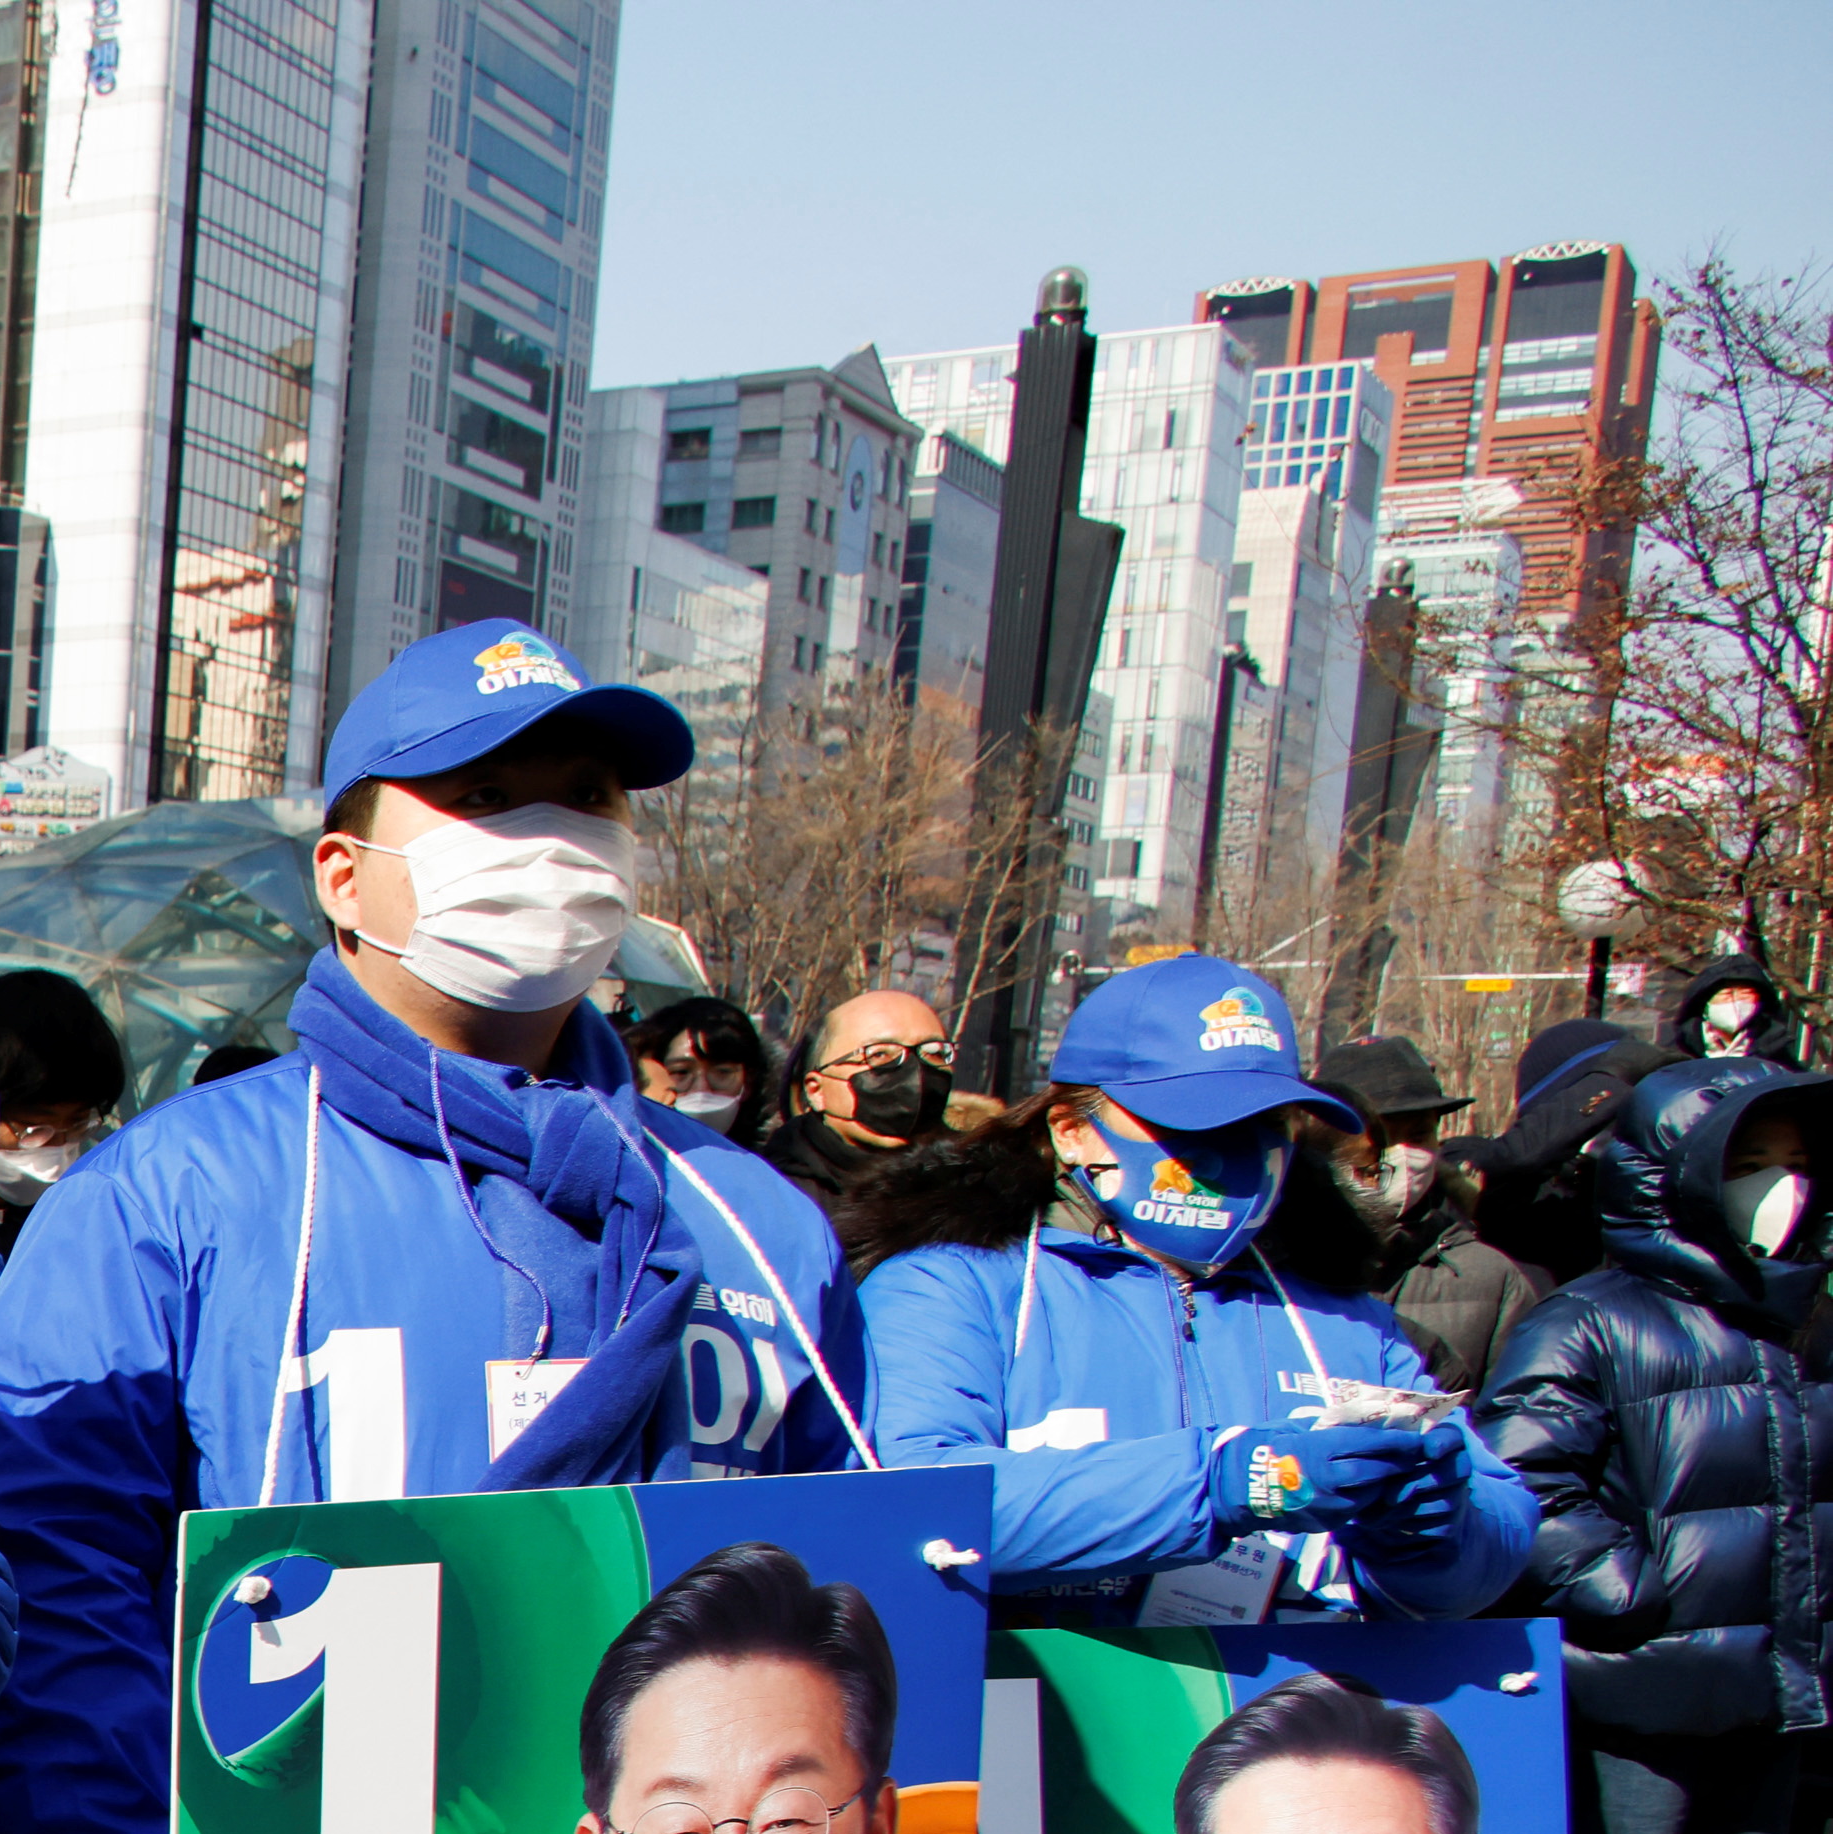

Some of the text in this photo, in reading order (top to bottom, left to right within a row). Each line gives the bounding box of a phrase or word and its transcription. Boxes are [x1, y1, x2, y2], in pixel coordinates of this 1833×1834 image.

[1199, 1027, 1282, 1051] 이재명
[1132, 1200, 1232, 1230] 이재명
[720, 1287, 777, 1327] 위해
